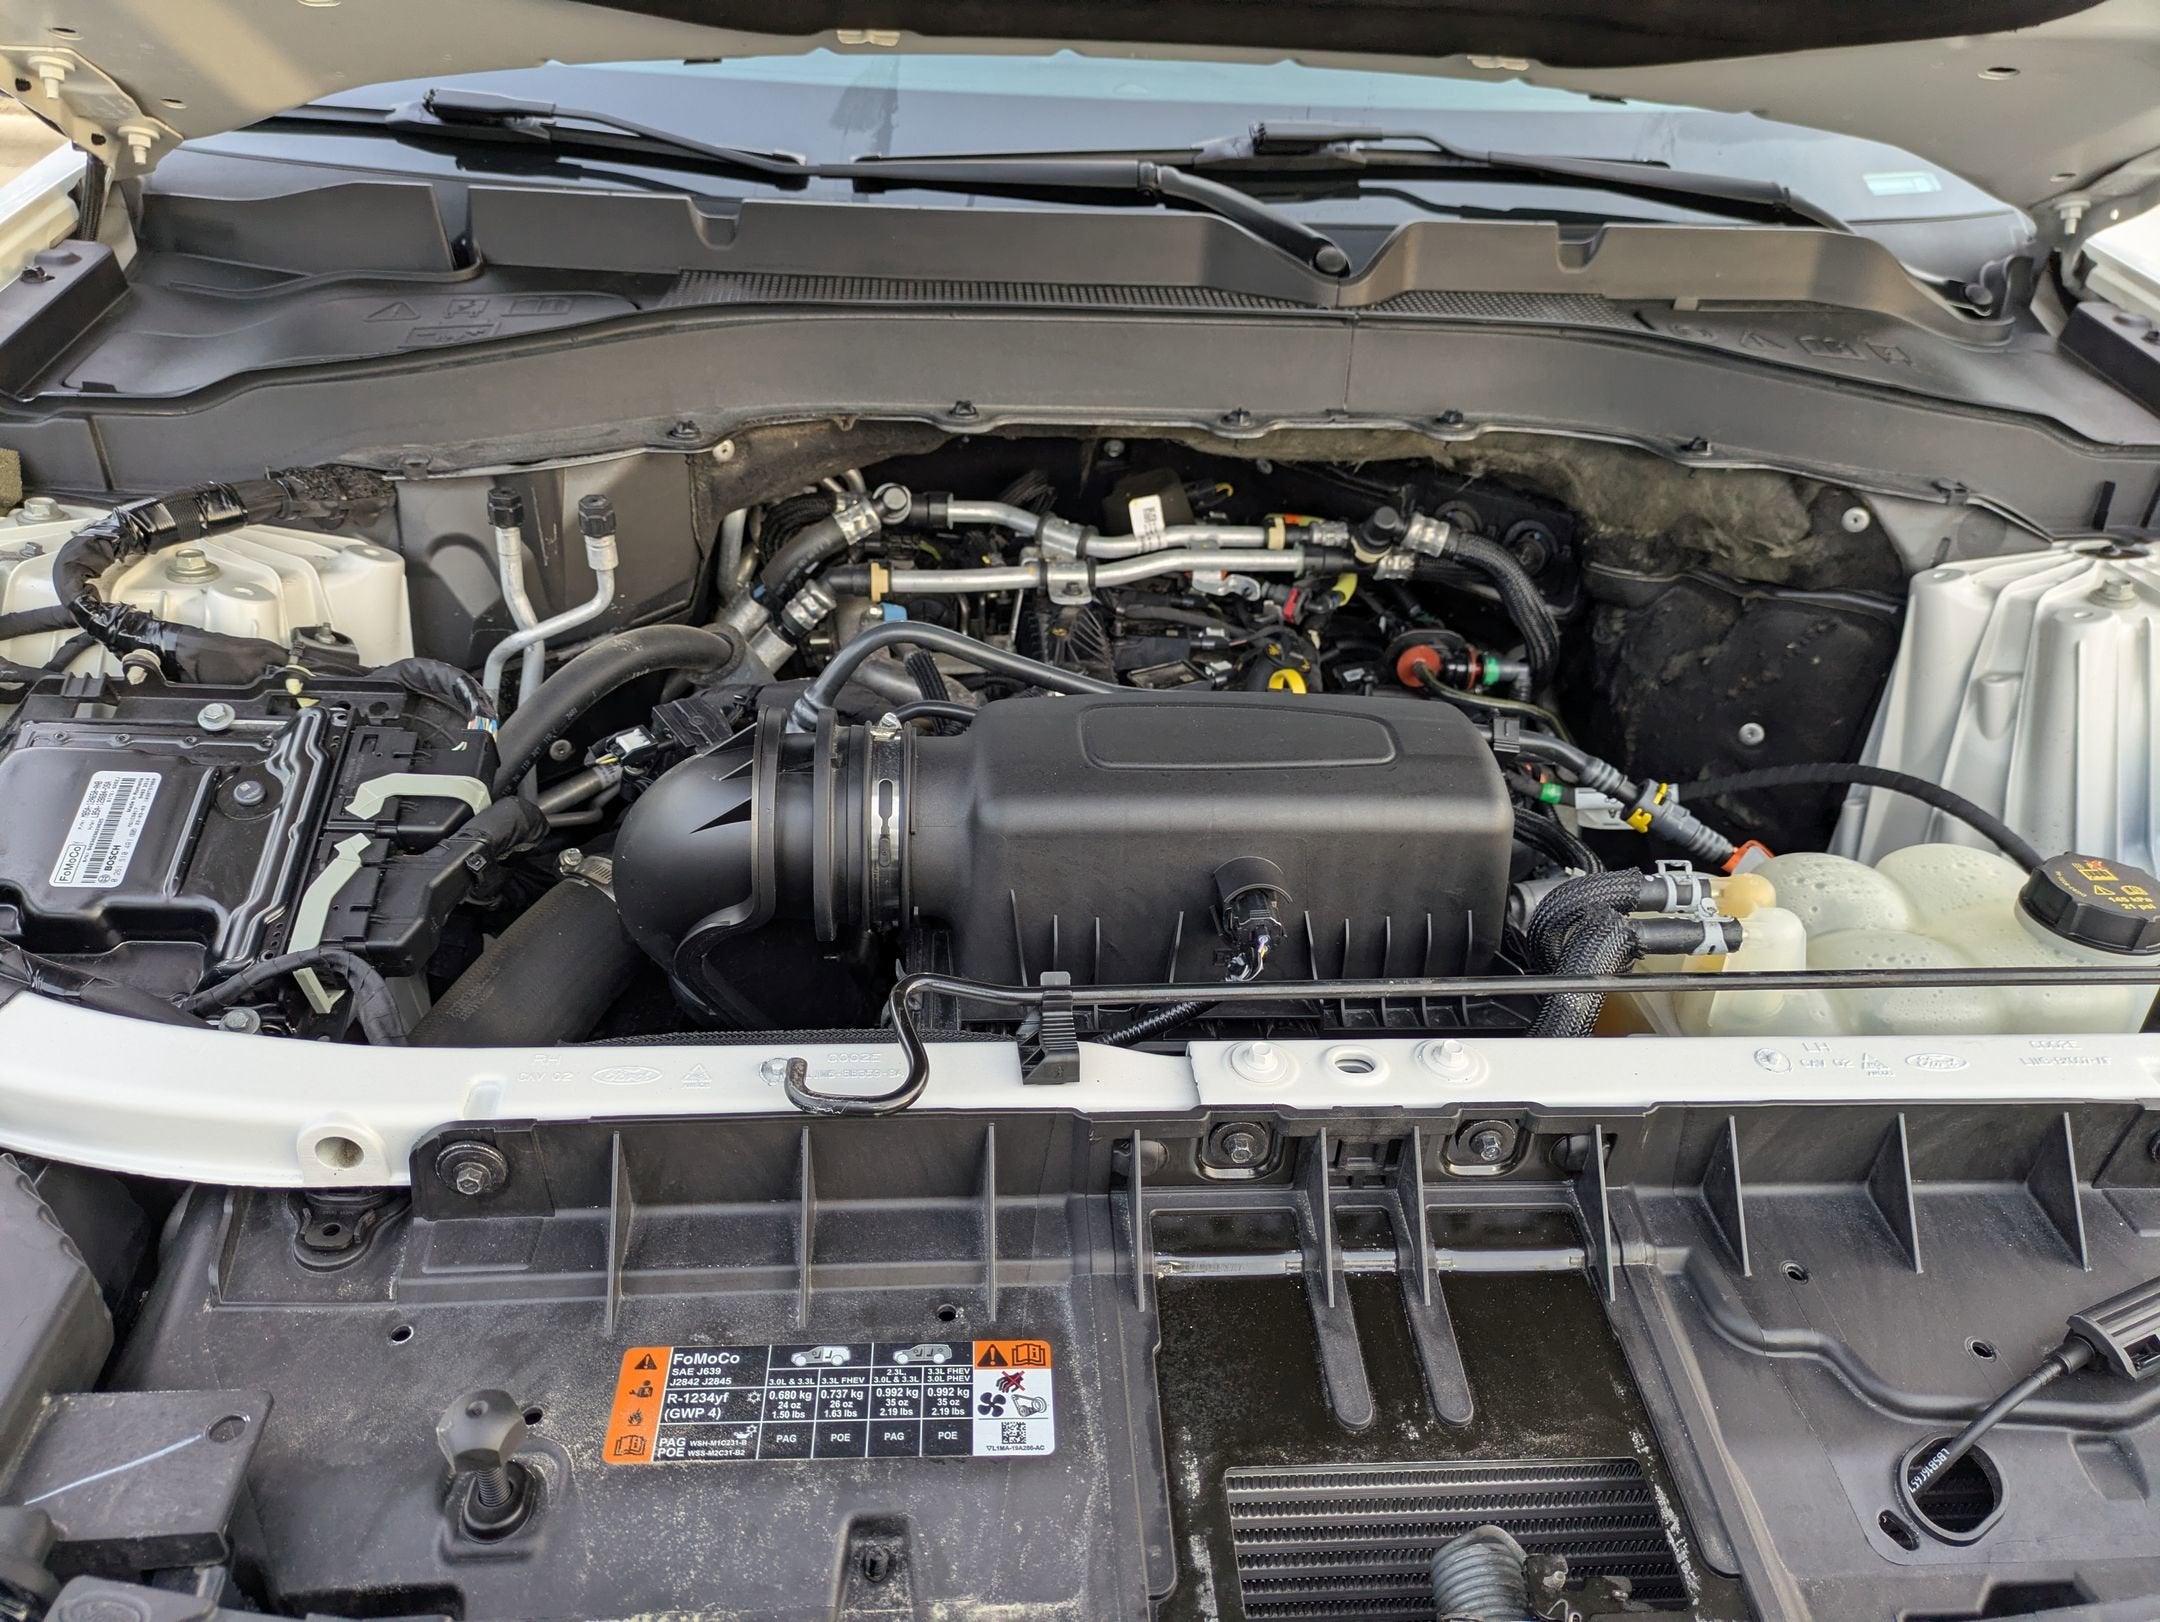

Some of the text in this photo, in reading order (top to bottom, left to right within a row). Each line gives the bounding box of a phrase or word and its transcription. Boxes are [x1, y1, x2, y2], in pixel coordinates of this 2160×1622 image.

[104, 845, 121, 871] BOSCH
[59, 846, 82, 881] FoMoCo
[1802, 1042, 1831, 1052] LH
[673, 1353, 740, 1365] FoMoCo
[670, 1377, 732, 1386] J2842 J2845
[821, 1376, 866, 1385] 3.3L FHEV
[667, 1392, 729, 1403] R-1234yf
[769, 1390, 812, 1401] 0.680 kg
[821, 1390, 863, 1400] 0.737 kg
[876, 1388, 918, 1398] 0.992 kg
[928, 1387, 970, 1398] 0.992 kg
[664, 1407, 721, 1422] (GWP 4)
[772, 1410, 805, 1419] 1.50 lbs
[824, 1410, 842, 1418] 1.63
[880, 1408, 913, 1416] 2.19 lbs
[952, 1407, 965, 1415] lbs
[659, 1437, 686, 1447] PAG
[776, 1435, 797, 1443] PAG
[831, 1434, 850, 1442] POE
[657, 1447, 684, 1457] POE
